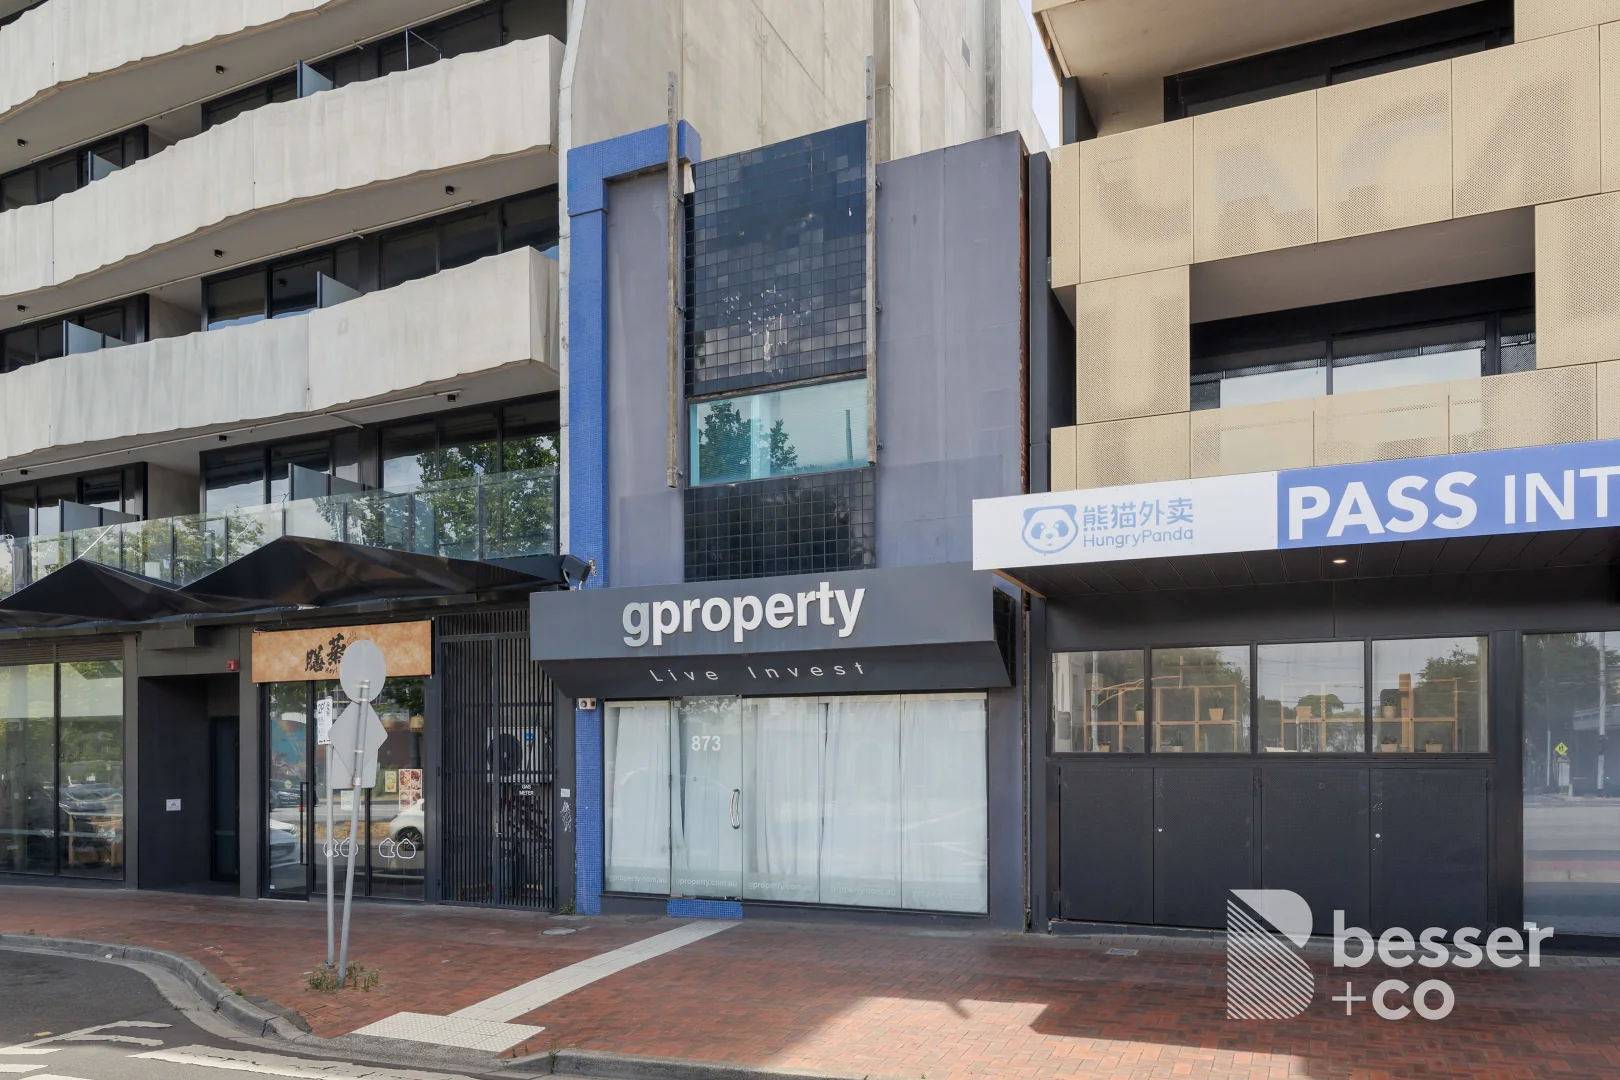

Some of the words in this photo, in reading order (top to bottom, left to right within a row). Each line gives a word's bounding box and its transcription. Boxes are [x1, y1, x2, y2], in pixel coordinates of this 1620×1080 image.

[1083, 497, 1194, 532] 熊猫外卖
[1288, 471, 1478, 541] PASS
[1083, 527, 1194, 549] HungryPanda
[622, 581, 866, 647] gproperty
[649, 668, 719, 682] Live
[747, 662, 865, 680] Invest
[691, 735, 721, 751] 873
[675, 877, 738, 888] gproperty.com.au
